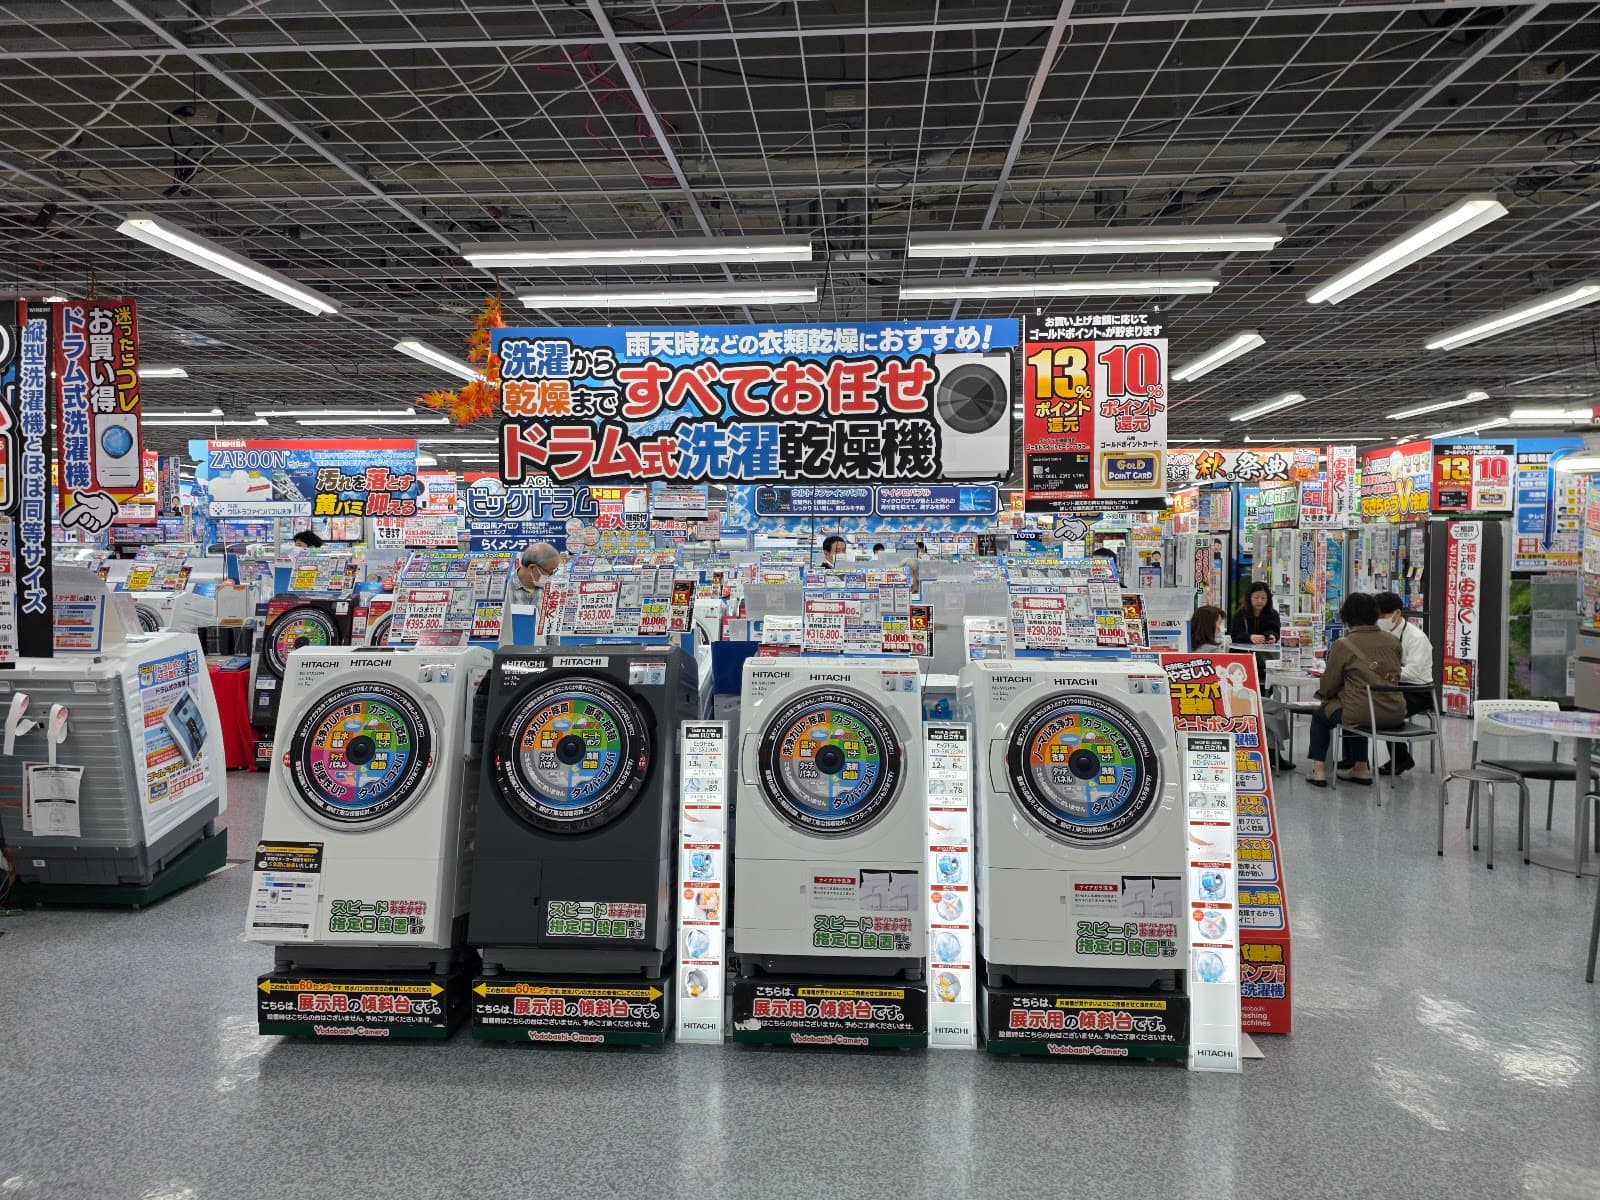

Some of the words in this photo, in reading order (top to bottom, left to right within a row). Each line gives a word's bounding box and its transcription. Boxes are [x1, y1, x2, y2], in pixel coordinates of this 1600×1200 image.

[1045, 315, 1148, 327] お買い上げ金額に応じて
[625, 325, 993, 357] 雨天時などの衣類乾燥におすすめ!
[89, 307, 116, 413] お買い得
[502, 341, 615, 378] 洗濯から
[618, 360, 934, 418] すべてお任せ
[62, 306, 91, 489] ドラム式洗濯機
[503, 380, 618, 416] 乾燥まで
[1036, 401, 1090, 417] ポイント
[1101, 400, 1163, 416] ポイント
[1116, 416, 1149, 432] 還元
[211, 440, 247, 448] TOSHIBA
[504, 420, 936, 480] ドラム式洗濯乾燥機
[316, 467, 415, 491] 汚れを落とす
[881, 488, 931, 497] マイクロバブル
[314, 492, 416, 516] 黄バミ抑える
[467, 488, 598, 518] ビッグドラム
[596, 513, 625, 529] 投入
[482, 539, 528, 551] らくメンテ
[350, 659, 392, 667] HITACHI
[506, 660, 545, 668] HITACHI
[560, 658, 601, 666] HITACHI
[809, 674, 851, 682] HITACHI
[1053, 678, 1097, 686] HITACHI
[1168, 666, 1215, 682] やさしい
[1170, 682, 1221, 698] コスパ
[331, 900, 388, 915] スピード
[549, 902, 607, 918] スピード
[330, 915, 408, 934] 指定日設置
[548, 918, 627, 937] 指定日設置
[814, 915, 873, 931] スピード
[1077, 921, 1137, 938] スピード
[813, 930, 894, 950] 指定日設置
[1076, 936, 1160, 957] 指定日設置
[756, 987, 794, 997] こちらは、
[261, 995, 441, 1015] こちらは、展示用の傾斜台です。
[476, 997, 660, 1019] こちらは、展示用の傾斜台です。
[753, 999, 904, 1021] 展示用の傾斜台です。
[1012, 997, 1053, 1008] こちらは、
[760, 1020, 913, 1031] はこちらの台はございません。予めご了承くださいませ。
[1009, 1010, 1167, 1032] 展示用の傾斜台です。
[1241, 1013, 1268, 1022] ashing
[314, 1026, 389, 1037] Yodobashi-Camera
[683, 1022, 716, 1030] HITACHI
[934, 1026, 969, 1034] HITACHI
[528, 1030, 604, 1042] Yodobashi-Camera
[791, 1032, 869, 1045] Yodobashi-Camera
[1048, 1043, 1128, 1056] Yodobashi-Camera
[1197, 1048, 1233, 1057] HITACHI
